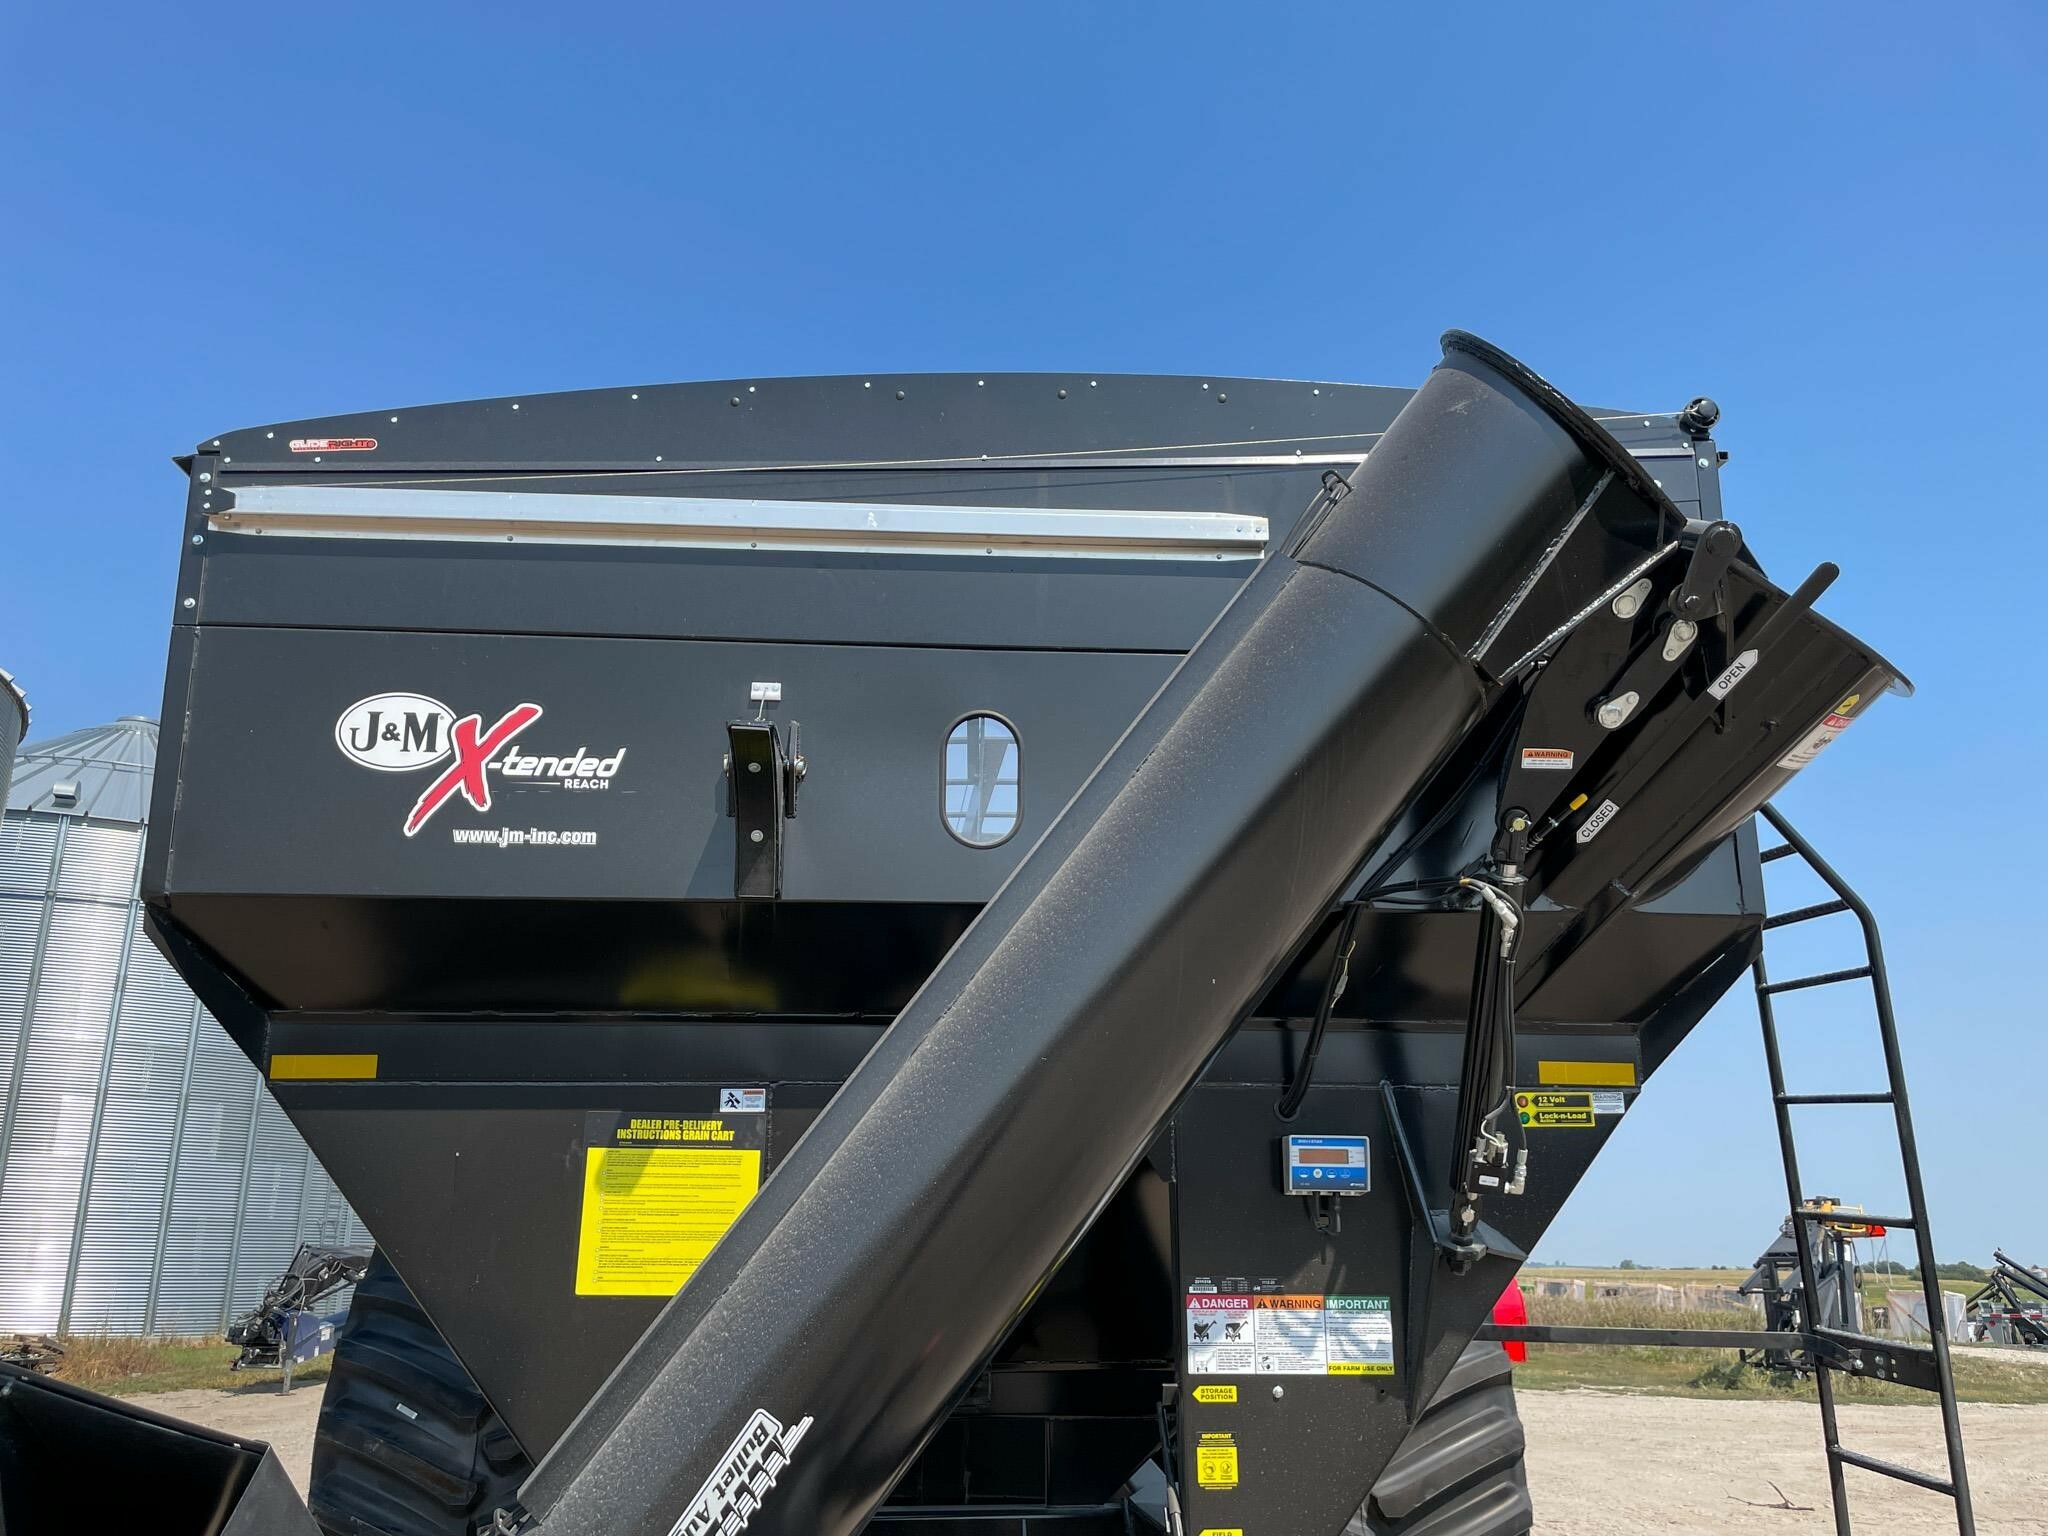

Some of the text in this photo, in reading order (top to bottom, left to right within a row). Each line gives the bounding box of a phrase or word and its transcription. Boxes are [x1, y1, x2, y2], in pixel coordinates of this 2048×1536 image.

[1718, 662, 1747, 690] OPEN
[350, 711, 441, 752] J&M
[564, 778, 609, 789] REACH
[1581, 804, 1614, 838] CLOSED
[453, 828, 597, 847] www.jm-inc.com
[631, 1119, 722, 1130] DEALER PRE-DELIVERY
[617, 1129, 735, 1141] INSTRUCTIONS GRAIN CART
[1202, 1298, 1249, 1308] DANGER
[1270, 1299, 1321, 1309] WARNING
[1326, 1299, 1389, 1309] IMPORTANT
[713, 1422, 770, 1500] Bullet
